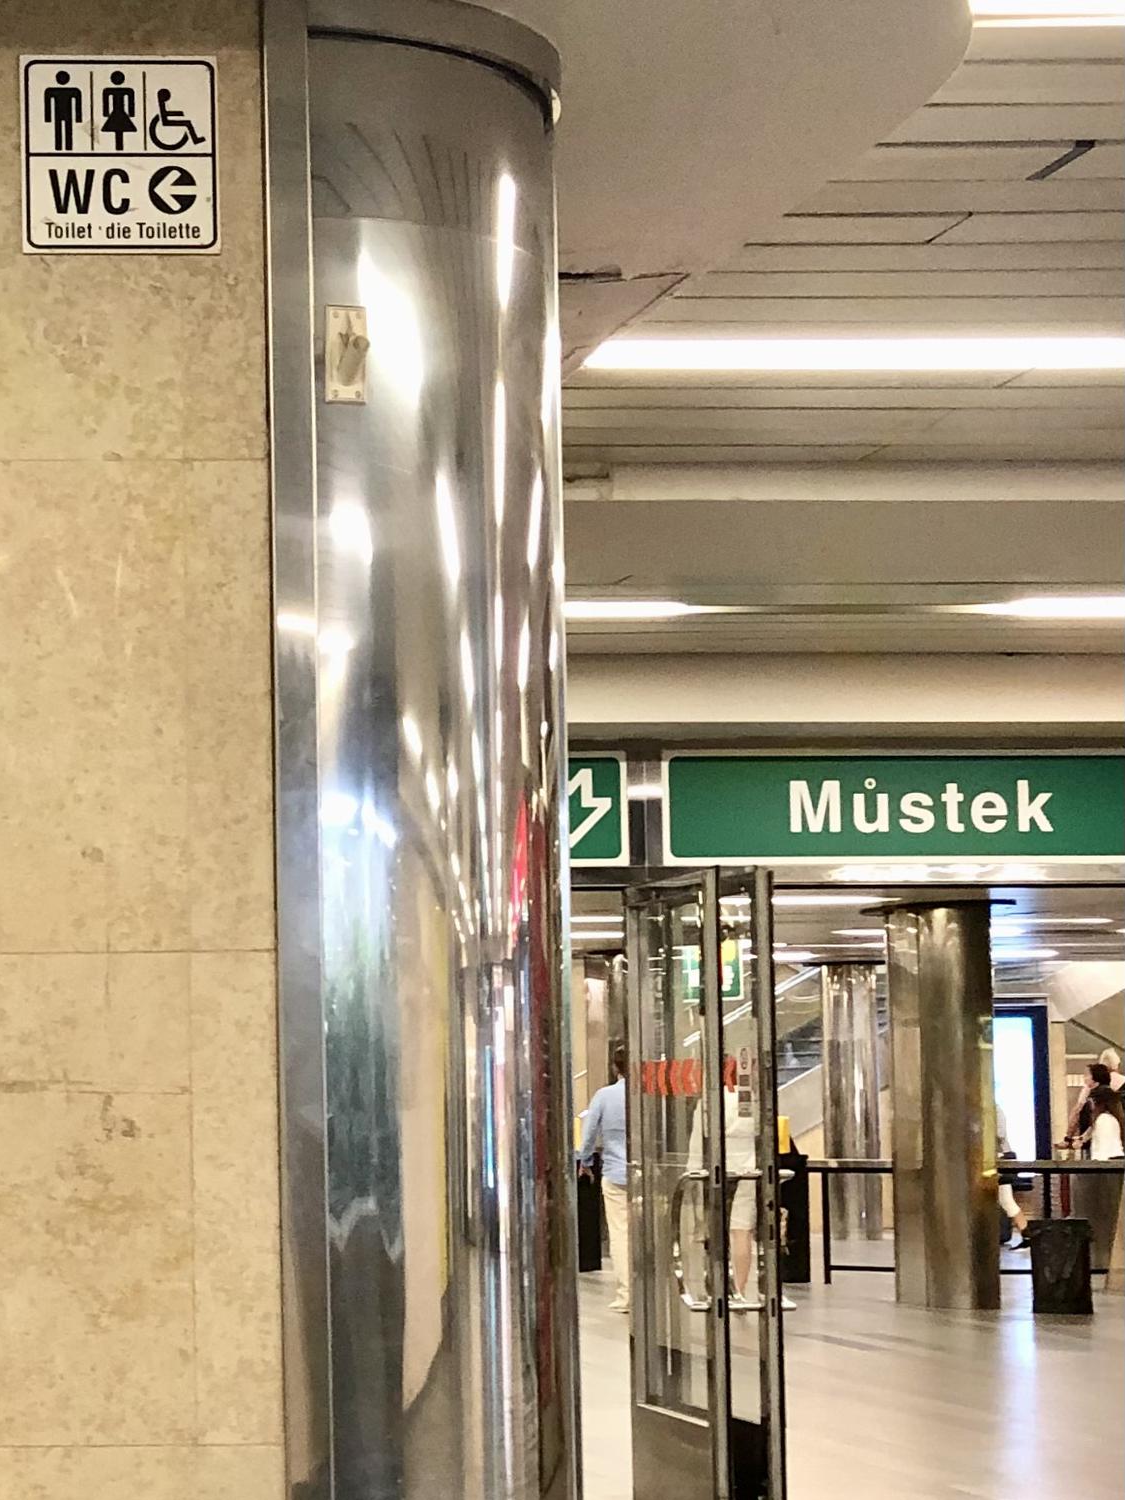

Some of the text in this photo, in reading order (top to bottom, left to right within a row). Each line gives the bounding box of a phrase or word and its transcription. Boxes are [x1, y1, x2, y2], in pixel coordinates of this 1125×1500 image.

[48, 167, 131, 216] WC
[45, 221, 201, 240] Toilet die Toilette
[788, 777, 1055, 834] Můstek
